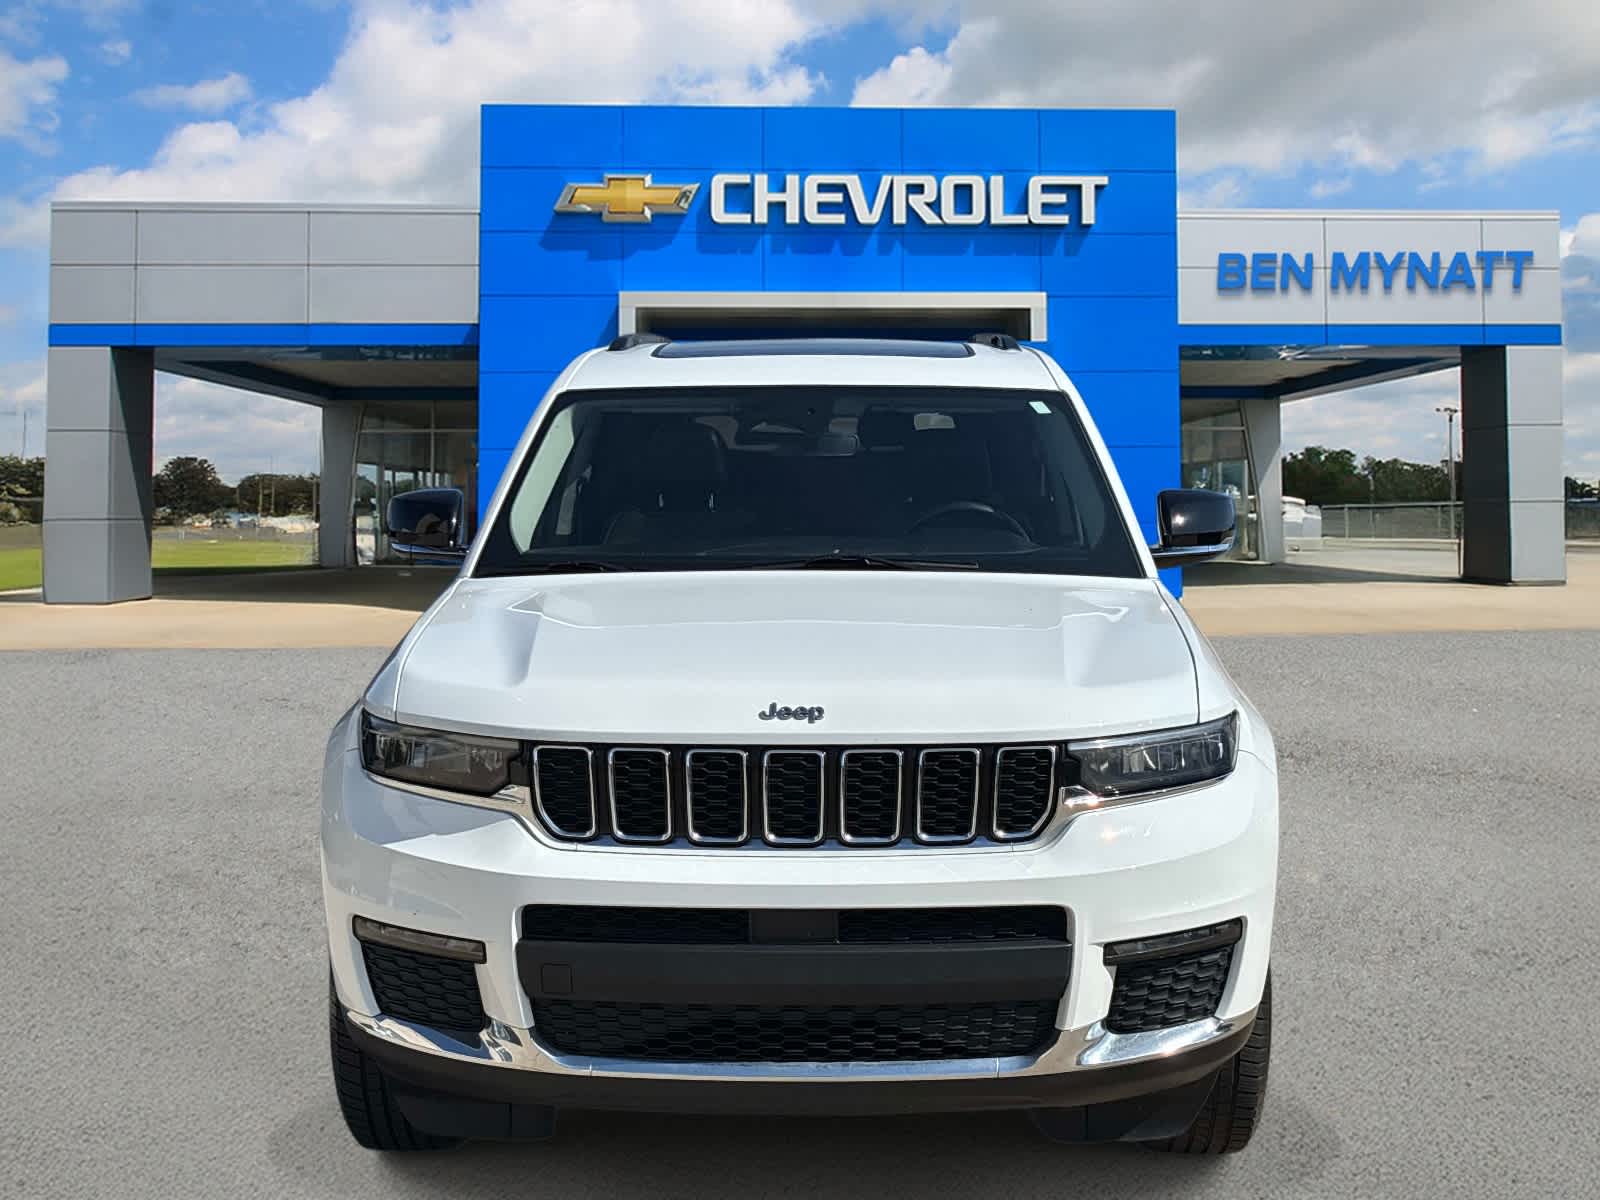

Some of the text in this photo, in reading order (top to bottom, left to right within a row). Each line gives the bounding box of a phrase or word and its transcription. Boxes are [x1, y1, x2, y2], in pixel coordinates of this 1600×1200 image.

[710, 174, 1109, 225] CHEVROLET
[1217, 251, 1534, 290] BEN MYNATT
[758, 702, 824, 724] Jeep
